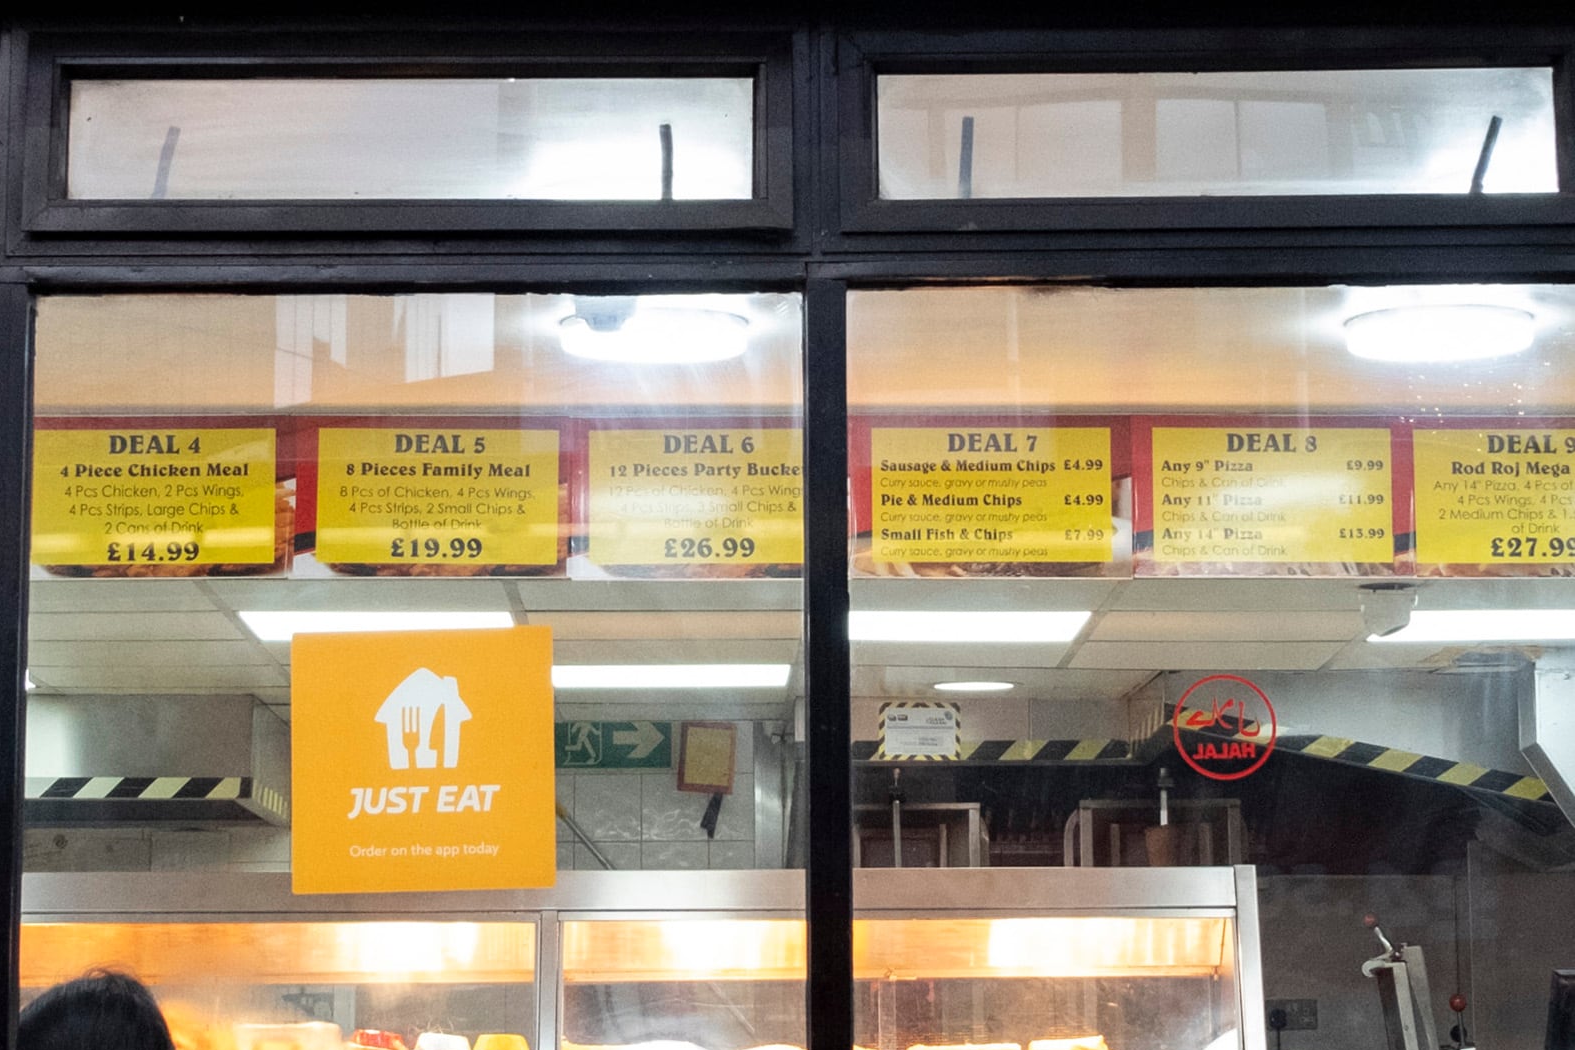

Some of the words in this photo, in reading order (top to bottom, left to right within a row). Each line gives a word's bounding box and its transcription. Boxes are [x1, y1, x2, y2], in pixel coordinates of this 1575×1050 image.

[109, 435, 179, 454] DEAL
[189, 437, 201, 454] 4
[395, 434, 465, 453] DEAL
[474, 437, 486, 453] 5
[663, 434, 733, 454] DEAL
[741, 436, 754, 454] 6
[948, 433, 1017, 452] DEAL
[1026, 435, 1037, 452] 7
[1227, 433, 1296, 452] DEAL
[1305, 436, 1317, 452] 8
[1487, 435, 1557, 454] DEAL
[1565, 437, 1575, 454] 9
[61, 465, 69, 477] 4
[75, 464, 121, 477] Piece
[128, 464, 200, 477] Chicken
[206, 463, 248, 476] Meal
[346, 463, 355, 476] 8
[361, 462, 416, 476] Pieces
[422, 462, 483, 479] Family
[488, 463, 530, 477] Meal
[610, 465, 627, 477] 12
[633, 464, 688, 477] Pieces
[694, 463, 741, 478] Party
[881, 460, 936, 474] Sausage
[941, 461, 950, 471] &
[956, 460, 1012, 472] Medium
[1017, 460, 1055, 474] Chips
[1064, 460, 1102, 470] £4.99
[1161, 461, 1190, 473] Any
[1196, 460, 1210, 471] 9"
[1215, 461, 1252, 472] Pizza
[1347, 460, 1383, 471] £9.99
[1451, 462, 1485, 475] Rod
[1492, 462, 1519, 477] Roj
[1526, 462, 1570, 477] Mega
[65, 485, 72, 497] 4
[76, 485, 98, 497] Pcs
[102, 484, 160, 498] Chicken,
[166, 484, 173, 496] 2
[177, 484, 198, 497] Pcs
[880, 478, 906, 488] Curry
[945, 480, 974, 489] gravy
[988, 478, 1019, 489] mushy
[1022, 479, 1047, 489] peas
[1434, 480, 1457, 492] Any
[1524, 481, 1531, 490] 4
[1535, 480, 1556, 491] Pcs
[1561, 480, 1574, 491] of
[881, 494, 902, 505] Pie
[907, 495, 917, 505] &
[922, 494, 978, 506] Medium
[983, 494, 1022, 507] Chips
[1064, 495, 1103, 505] £4.99
[881, 529, 921, 540] Small
[927, 529, 954, 540] Fish
[960, 529, 970, 540] &
[975, 529, 1013, 542] Chips
[1065, 530, 1104, 540] £7.99
[1162, 529, 1191, 540] Any
[1225, 529, 1262, 539] Pizza
[1340, 529, 1385, 539] £13.99
[1512, 524, 1523, 534] of
[1529, 523, 1560, 533] Drink
[107, 542, 199, 561] £14.99
[391, 538, 483, 558] £19.99
[664, 538, 755, 557] £26.99
[348, 786, 429, 820] JUST
[436, 784, 501, 813] EAT
[350, 845, 386, 857] Order
[391, 847, 407, 856] on
[411, 844, 431, 856] the
[436, 846, 459, 857] app
[464, 842, 499, 856] today
